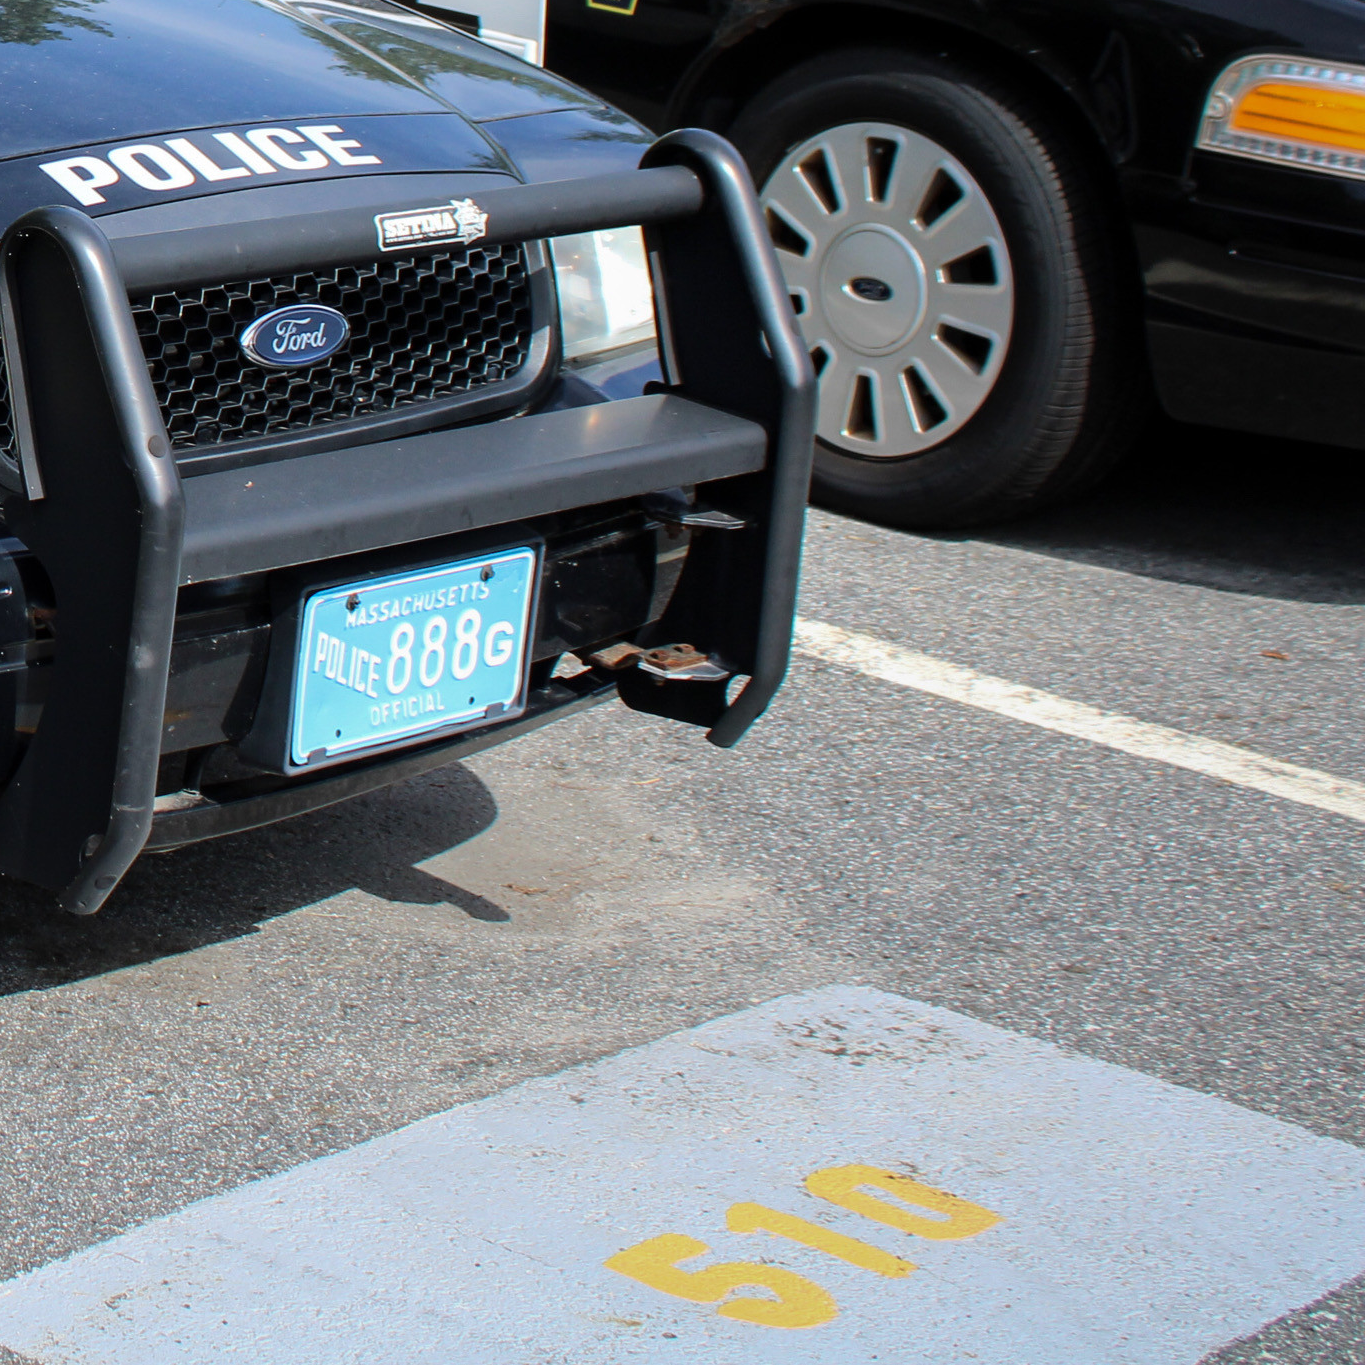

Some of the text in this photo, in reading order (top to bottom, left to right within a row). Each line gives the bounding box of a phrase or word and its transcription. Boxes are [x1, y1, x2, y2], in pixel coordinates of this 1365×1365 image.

[38, 124, 383, 207] POLICE
[381, 211, 458, 239] SETINA
[272, 317, 327, 354] Ford
[345, 580, 491, 628] MASSACHUSETTS
[312, 631, 382, 699] POLICE
[370, 688, 447, 727] OFFICIAL
[602, 1163, 1007, 1330] 510
